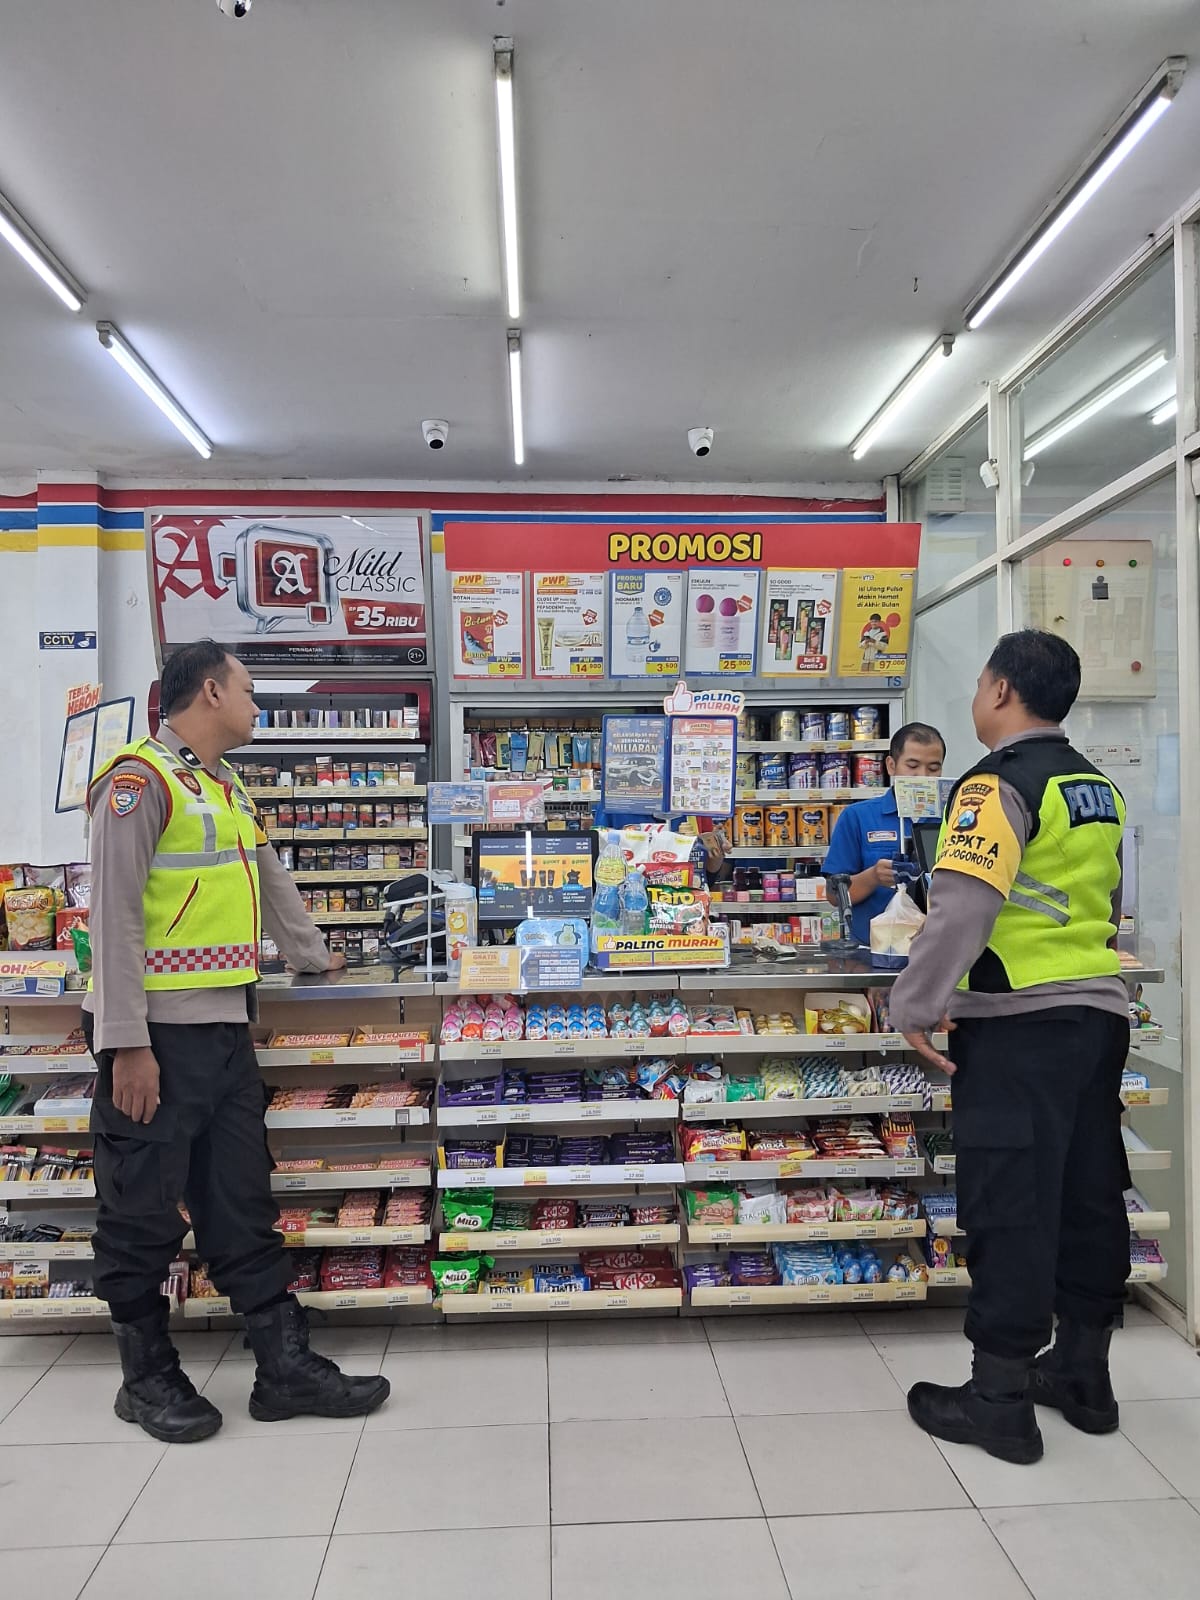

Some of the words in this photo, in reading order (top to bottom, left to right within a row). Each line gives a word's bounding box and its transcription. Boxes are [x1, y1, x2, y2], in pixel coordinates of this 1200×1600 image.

[608, 533, 763, 562] PROMOSI
[323, 547, 403, 577] Mild
[335, 575, 416, 593] CLASSIC
[458, 575, 482, 584] PWP
[542, 575, 566, 584] PWP
[617, 582, 643, 590] BARU
[354, 606, 386, 627] 35
[385, 616, 418, 627] RIBU
[43, 635, 75, 645] CCTV
[885, 675, 902, 687] TS
[693, 692, 741, 704] PALING
[695, 702, 741, 713] MURAH
[612, 743, 659, 753] MILIARAN
[987, 842, 999, 858] A
[647, 887, 695, 905] Taro
[615, 940, 664, 951] PALING
[667, 938, 718, 948] MURAH
[42, 1154, 74, 1163] Alkaline
[456, 1217, 479, 1227] MILO
[445, 1272, 468, 1281] MILO
